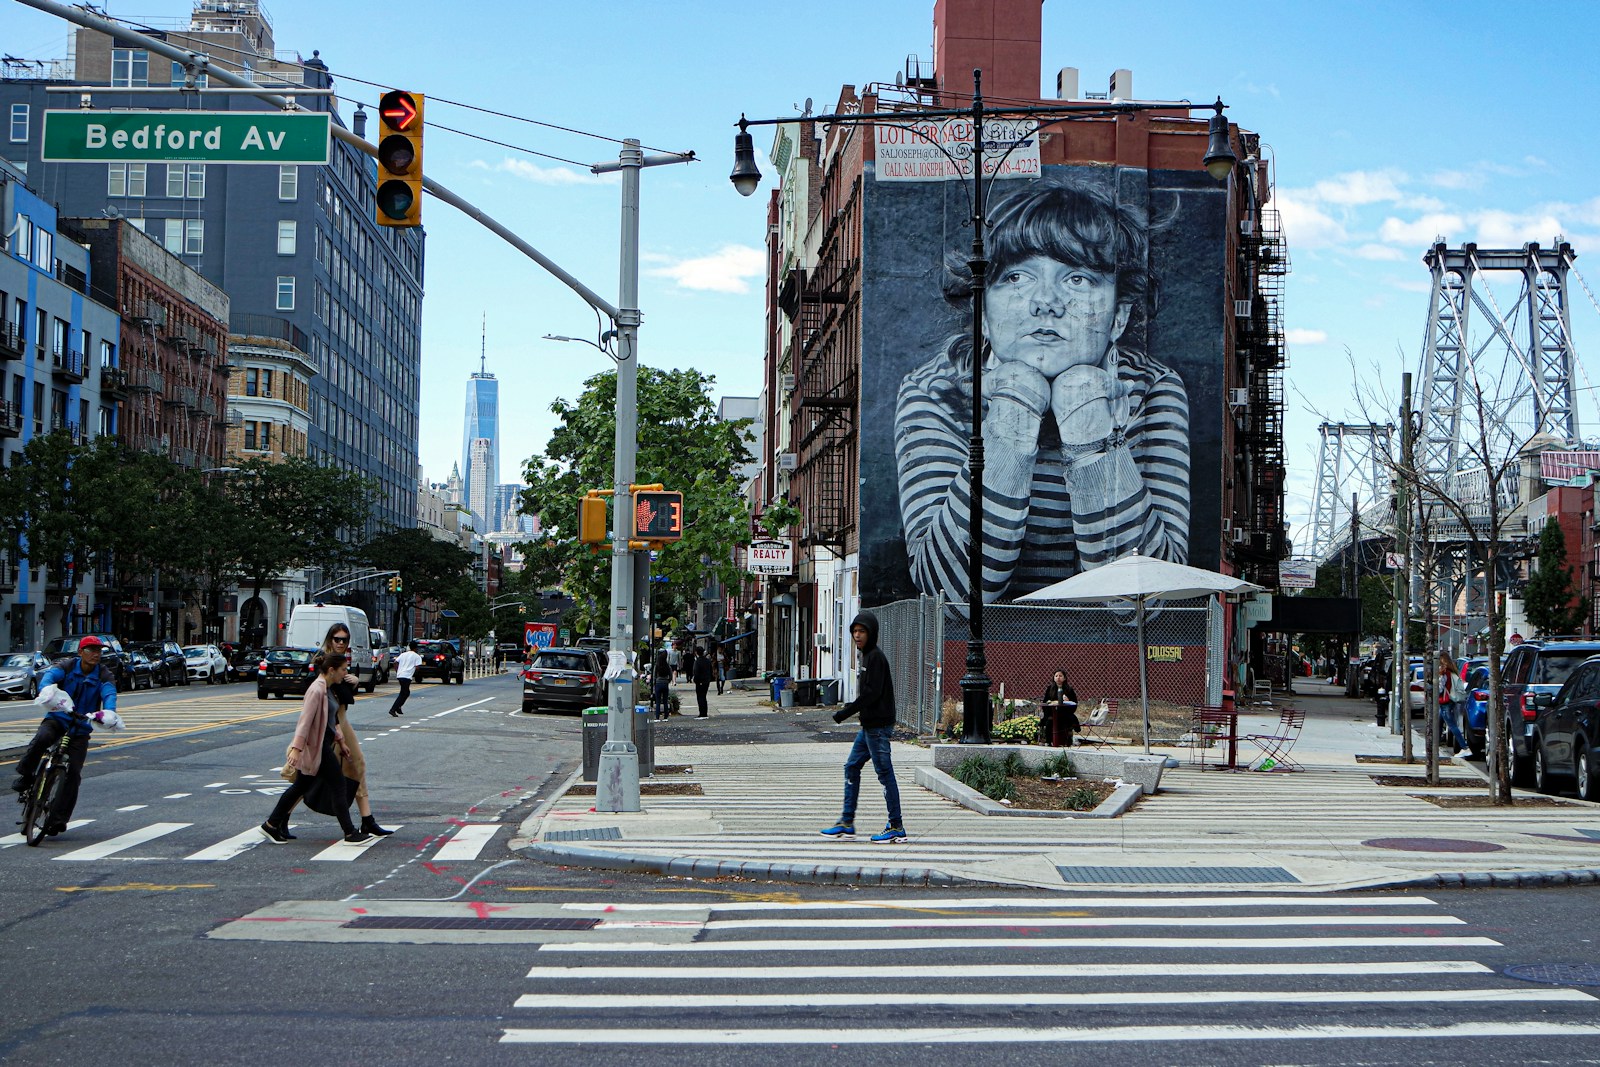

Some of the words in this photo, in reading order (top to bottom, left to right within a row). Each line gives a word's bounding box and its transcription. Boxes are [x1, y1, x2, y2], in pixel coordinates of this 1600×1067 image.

[85, 124, 221, 150] Bedford
[240, 125, 286, 150] Av
[879, 126, 905, 144] LOT
[911, 125, 940, 144] FOR
[942, 123, 974, 143] SALE
[884, 162, 903, 177] CALL
[904, 162, 918, 177] SAL
[919, 162, 944, 177] JOSEPH
[669, 502, 680, 532] 3
[753, 549, 786, 560] REALTY
[1147, 645, 1183, 660] COLOSSAL
